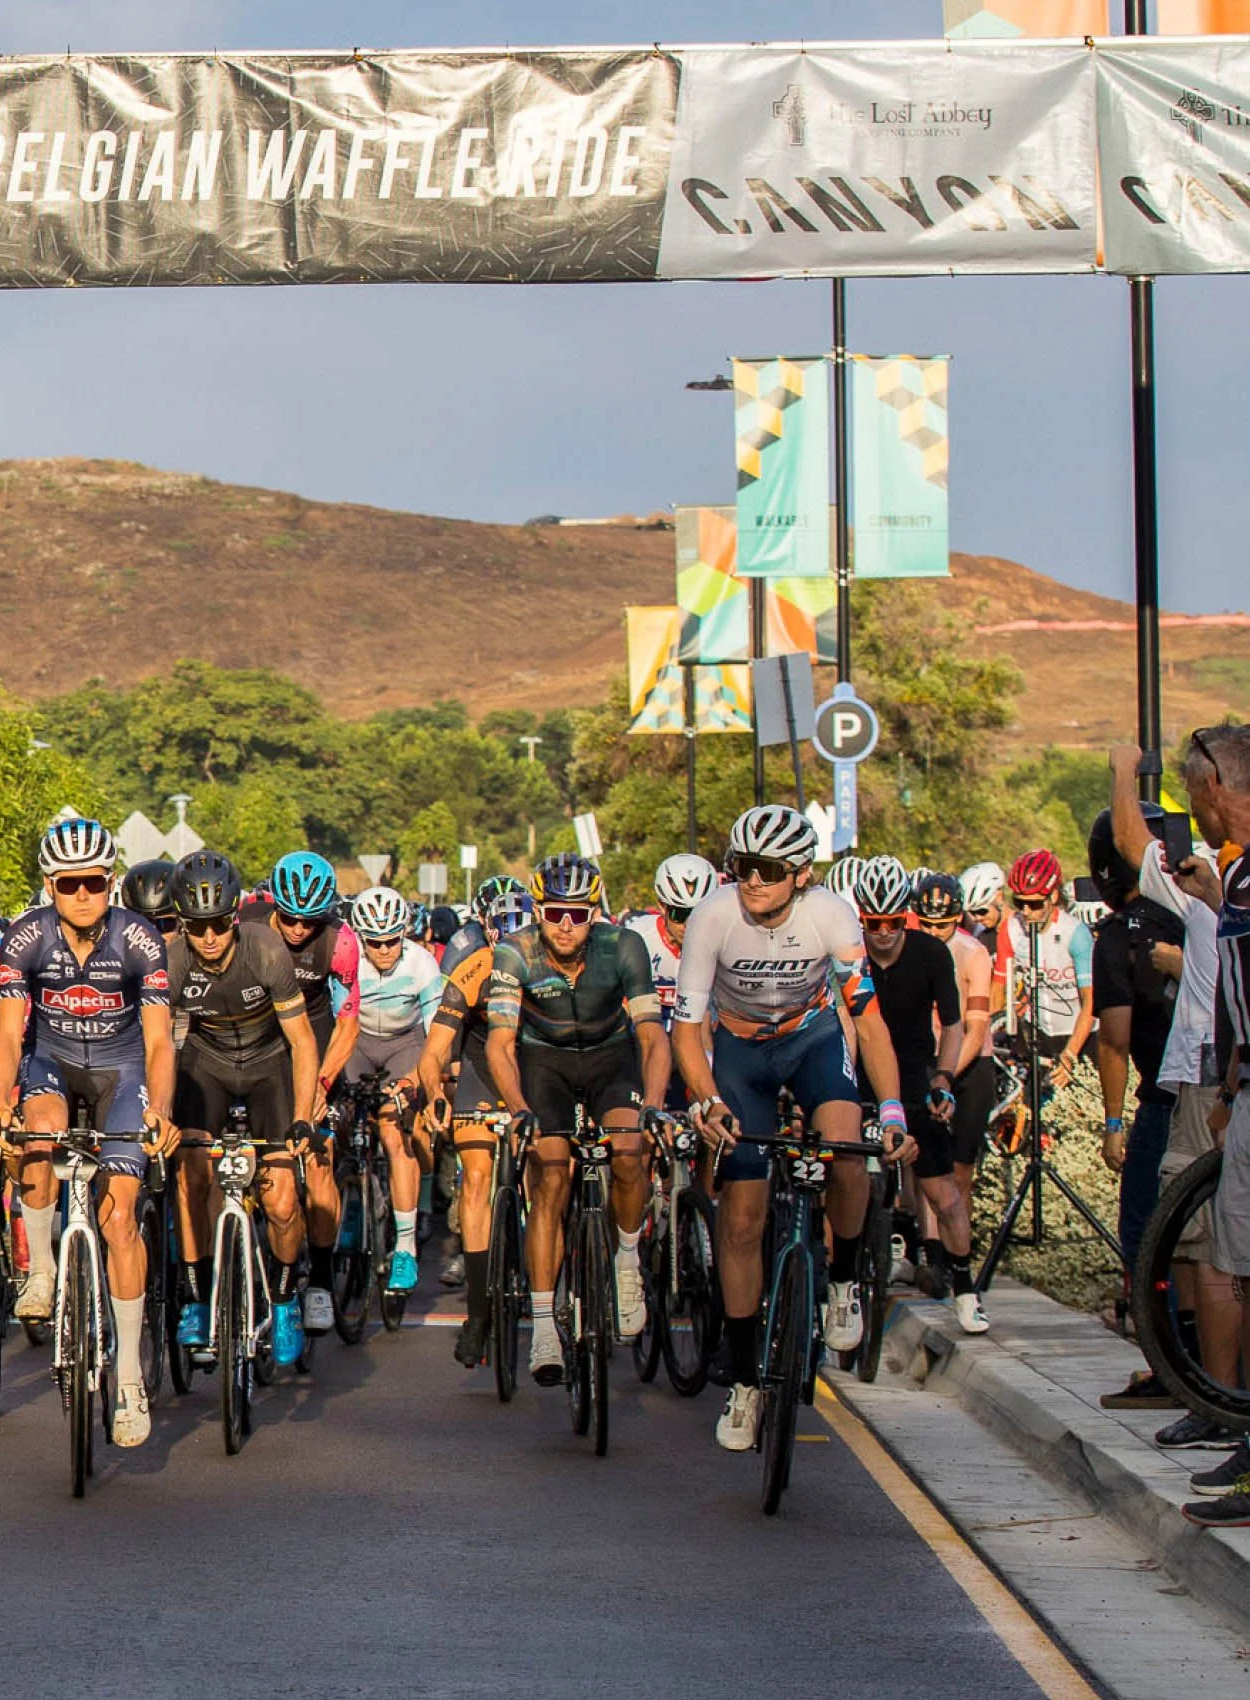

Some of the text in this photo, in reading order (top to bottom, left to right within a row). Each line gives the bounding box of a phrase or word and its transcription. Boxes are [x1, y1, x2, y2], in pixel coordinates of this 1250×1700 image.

[870, 102, 917, 124] Lost
[245, 126, 489, 203] WAFFLE
[502, 124, 647, 200] RIDE
[681, 174, 1081, 235] CANYON
[833, 712, 862, 739] P
[840, 770, 852, 829] PARK
[4, 920, 43, 958] FENIX
[122, 922, 162, 961] Alpecin
[732, 958, 817, 971] GIANT
[49, 994, 116, 1011] Alpecin
[49, 1019, 116, 1034] FENIX
[217, 1156, 249, 1175] 43
[792, 1160, 826, 1181] 22
